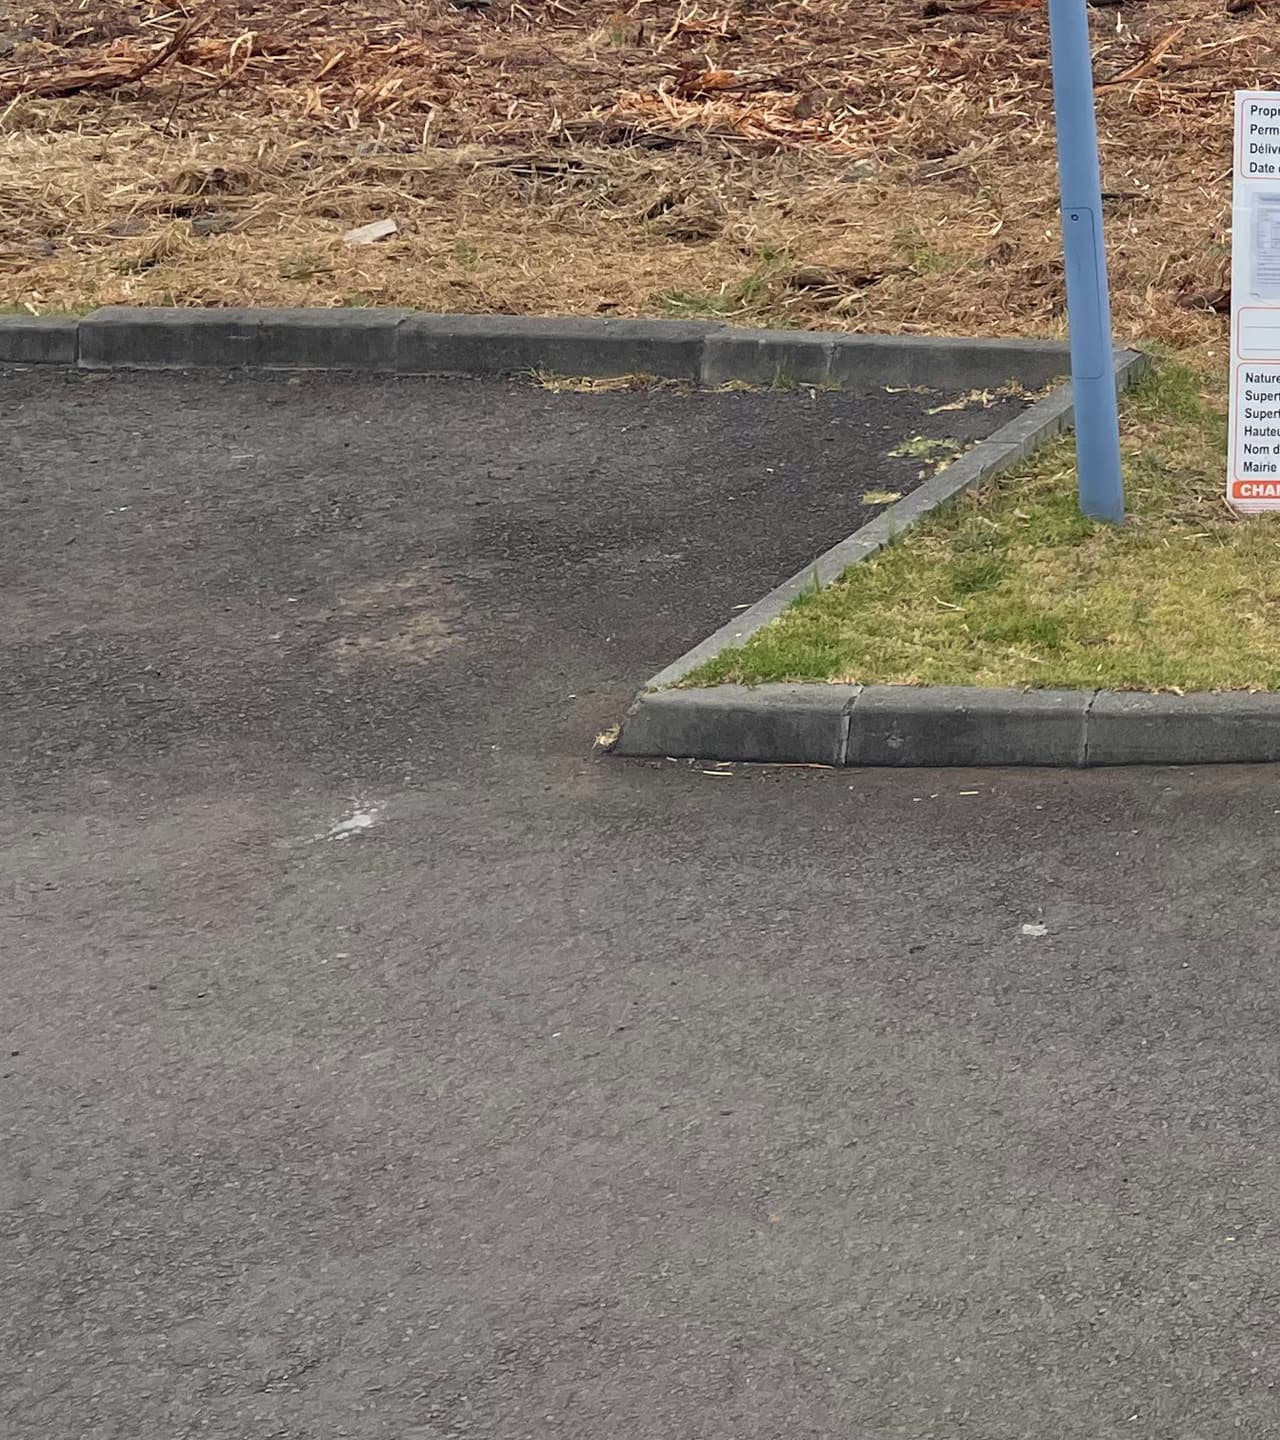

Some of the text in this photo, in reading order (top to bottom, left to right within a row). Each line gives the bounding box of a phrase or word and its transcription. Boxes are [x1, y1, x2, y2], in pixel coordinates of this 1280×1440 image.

[1250, 162, 1275, 173] Date
[1244, 444, 1270, 455] Nom
[1243, 462, 1277, 473] Mairie
